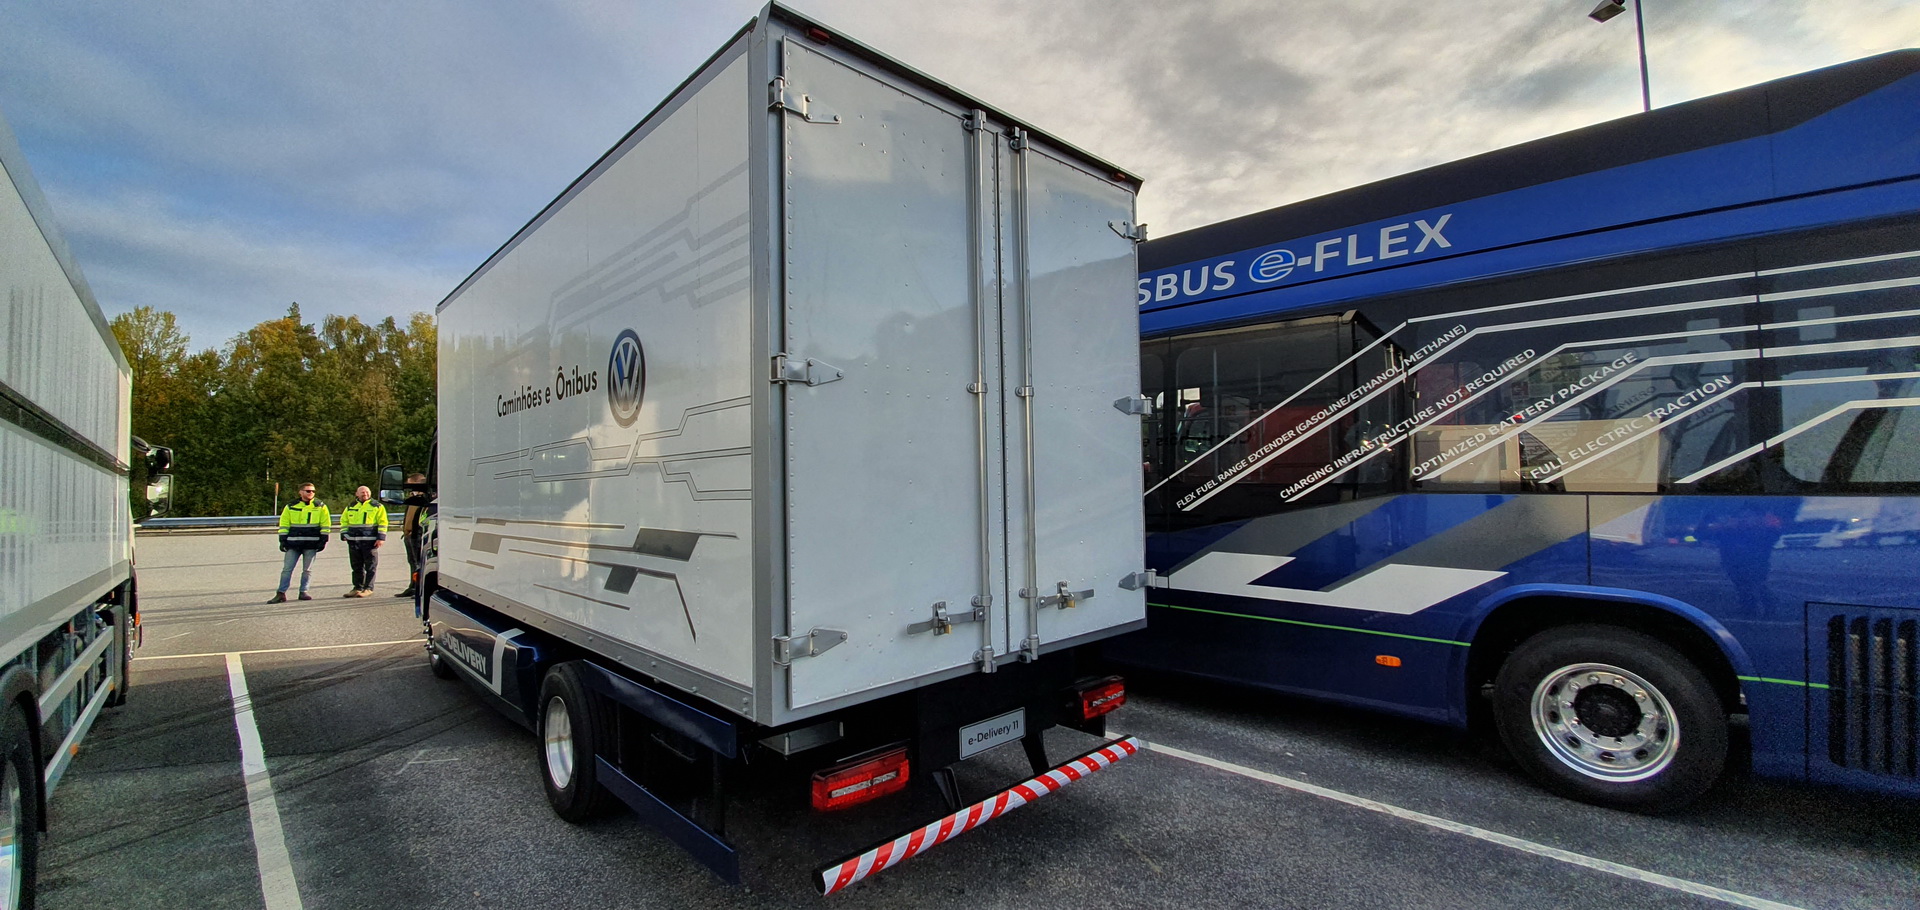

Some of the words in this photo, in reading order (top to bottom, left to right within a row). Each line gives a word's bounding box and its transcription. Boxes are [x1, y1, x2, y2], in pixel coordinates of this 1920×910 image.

[1138, 260, 1236, 306] SBUS
[1249, 213, 1453, 283] e-FLEX
[496, 384, 542, 418] Caminhões
[544, 386, 551, 404] e
[555, 365, 598, 400] Ônibus
[1279, 464, 1334, 499] CHARGING
[1333, 406, 1436, 469] INFRASTRUCTURE
[1435, 388, 1465, 411] NOT
[1465, 348, 1536, 393] REQUIRED
[1411, 432, 1487, 476] OPTIMIZED
[1488, 394, 1556, 436] BATTERY
[1557, 351, 1638, 399] PACKAGE
[1529, 457, 1569, 480] FULL
[1568, 419, 1644, 461] ELECTRIC
[1643, 374, 1733, 424] TRACTION
[1176, 491, 1197, 509] FLEX
[1195, 479, 1218, 496] FUEL
[1217, 459, 1248, 482] RANGE
[1247, 429, 1296, 463] EXTENDER
[968, 724, 1011, 745] e-Delivery
[1012, 719, 1019, 730] 11
